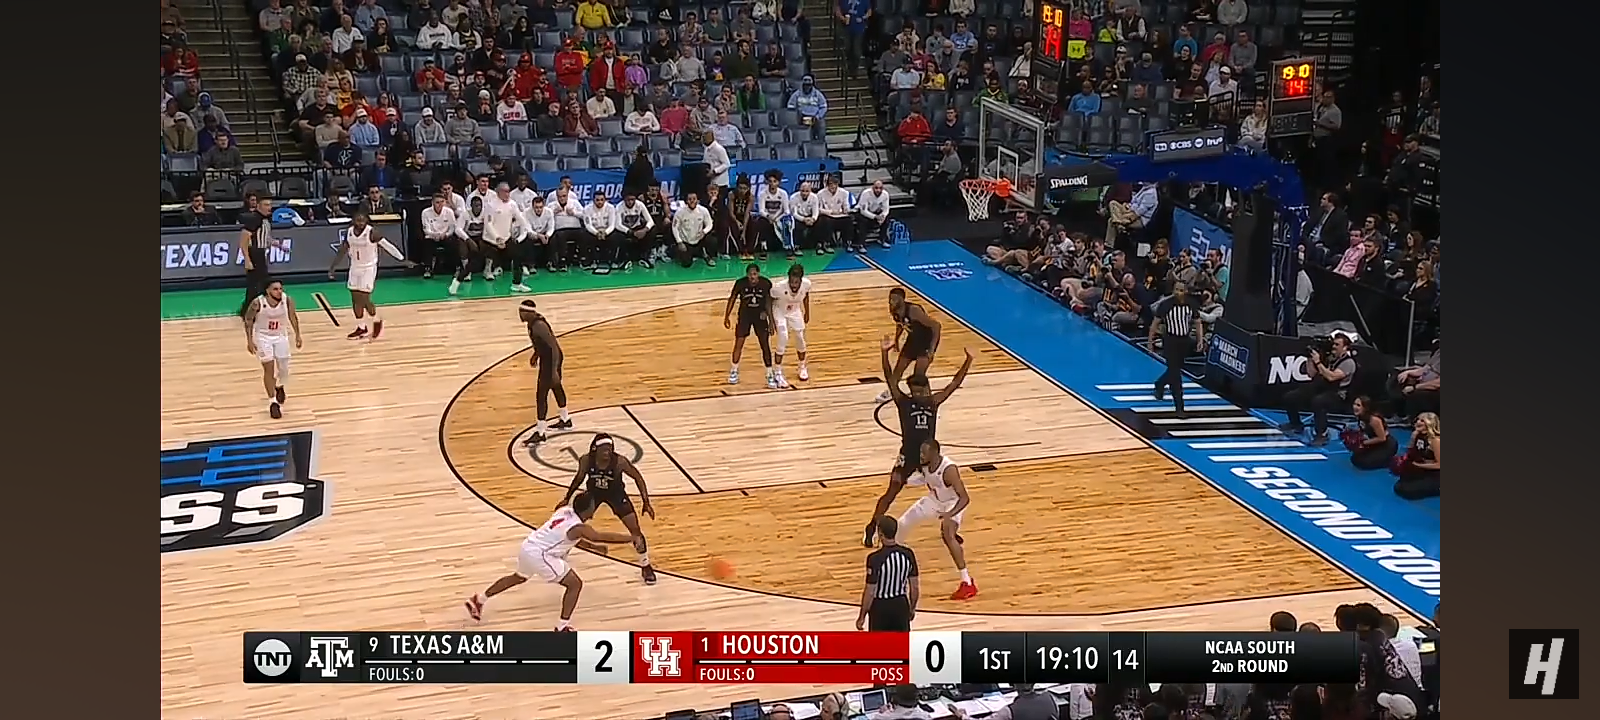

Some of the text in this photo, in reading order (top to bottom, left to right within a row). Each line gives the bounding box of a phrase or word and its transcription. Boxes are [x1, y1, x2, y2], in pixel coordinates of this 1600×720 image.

[1290, 80, 1304, 95] 14
[1050, 175, 1088, 189] SPALDING
[161, 242, 230, 268] EXAS
[1219, 339, 1239, 359] MARCH
[1220, 352, 1247, 374] MADNESS
[916, 415, 928, 425] 13
[1230, 466, 1440, 603] SECOND ROU
